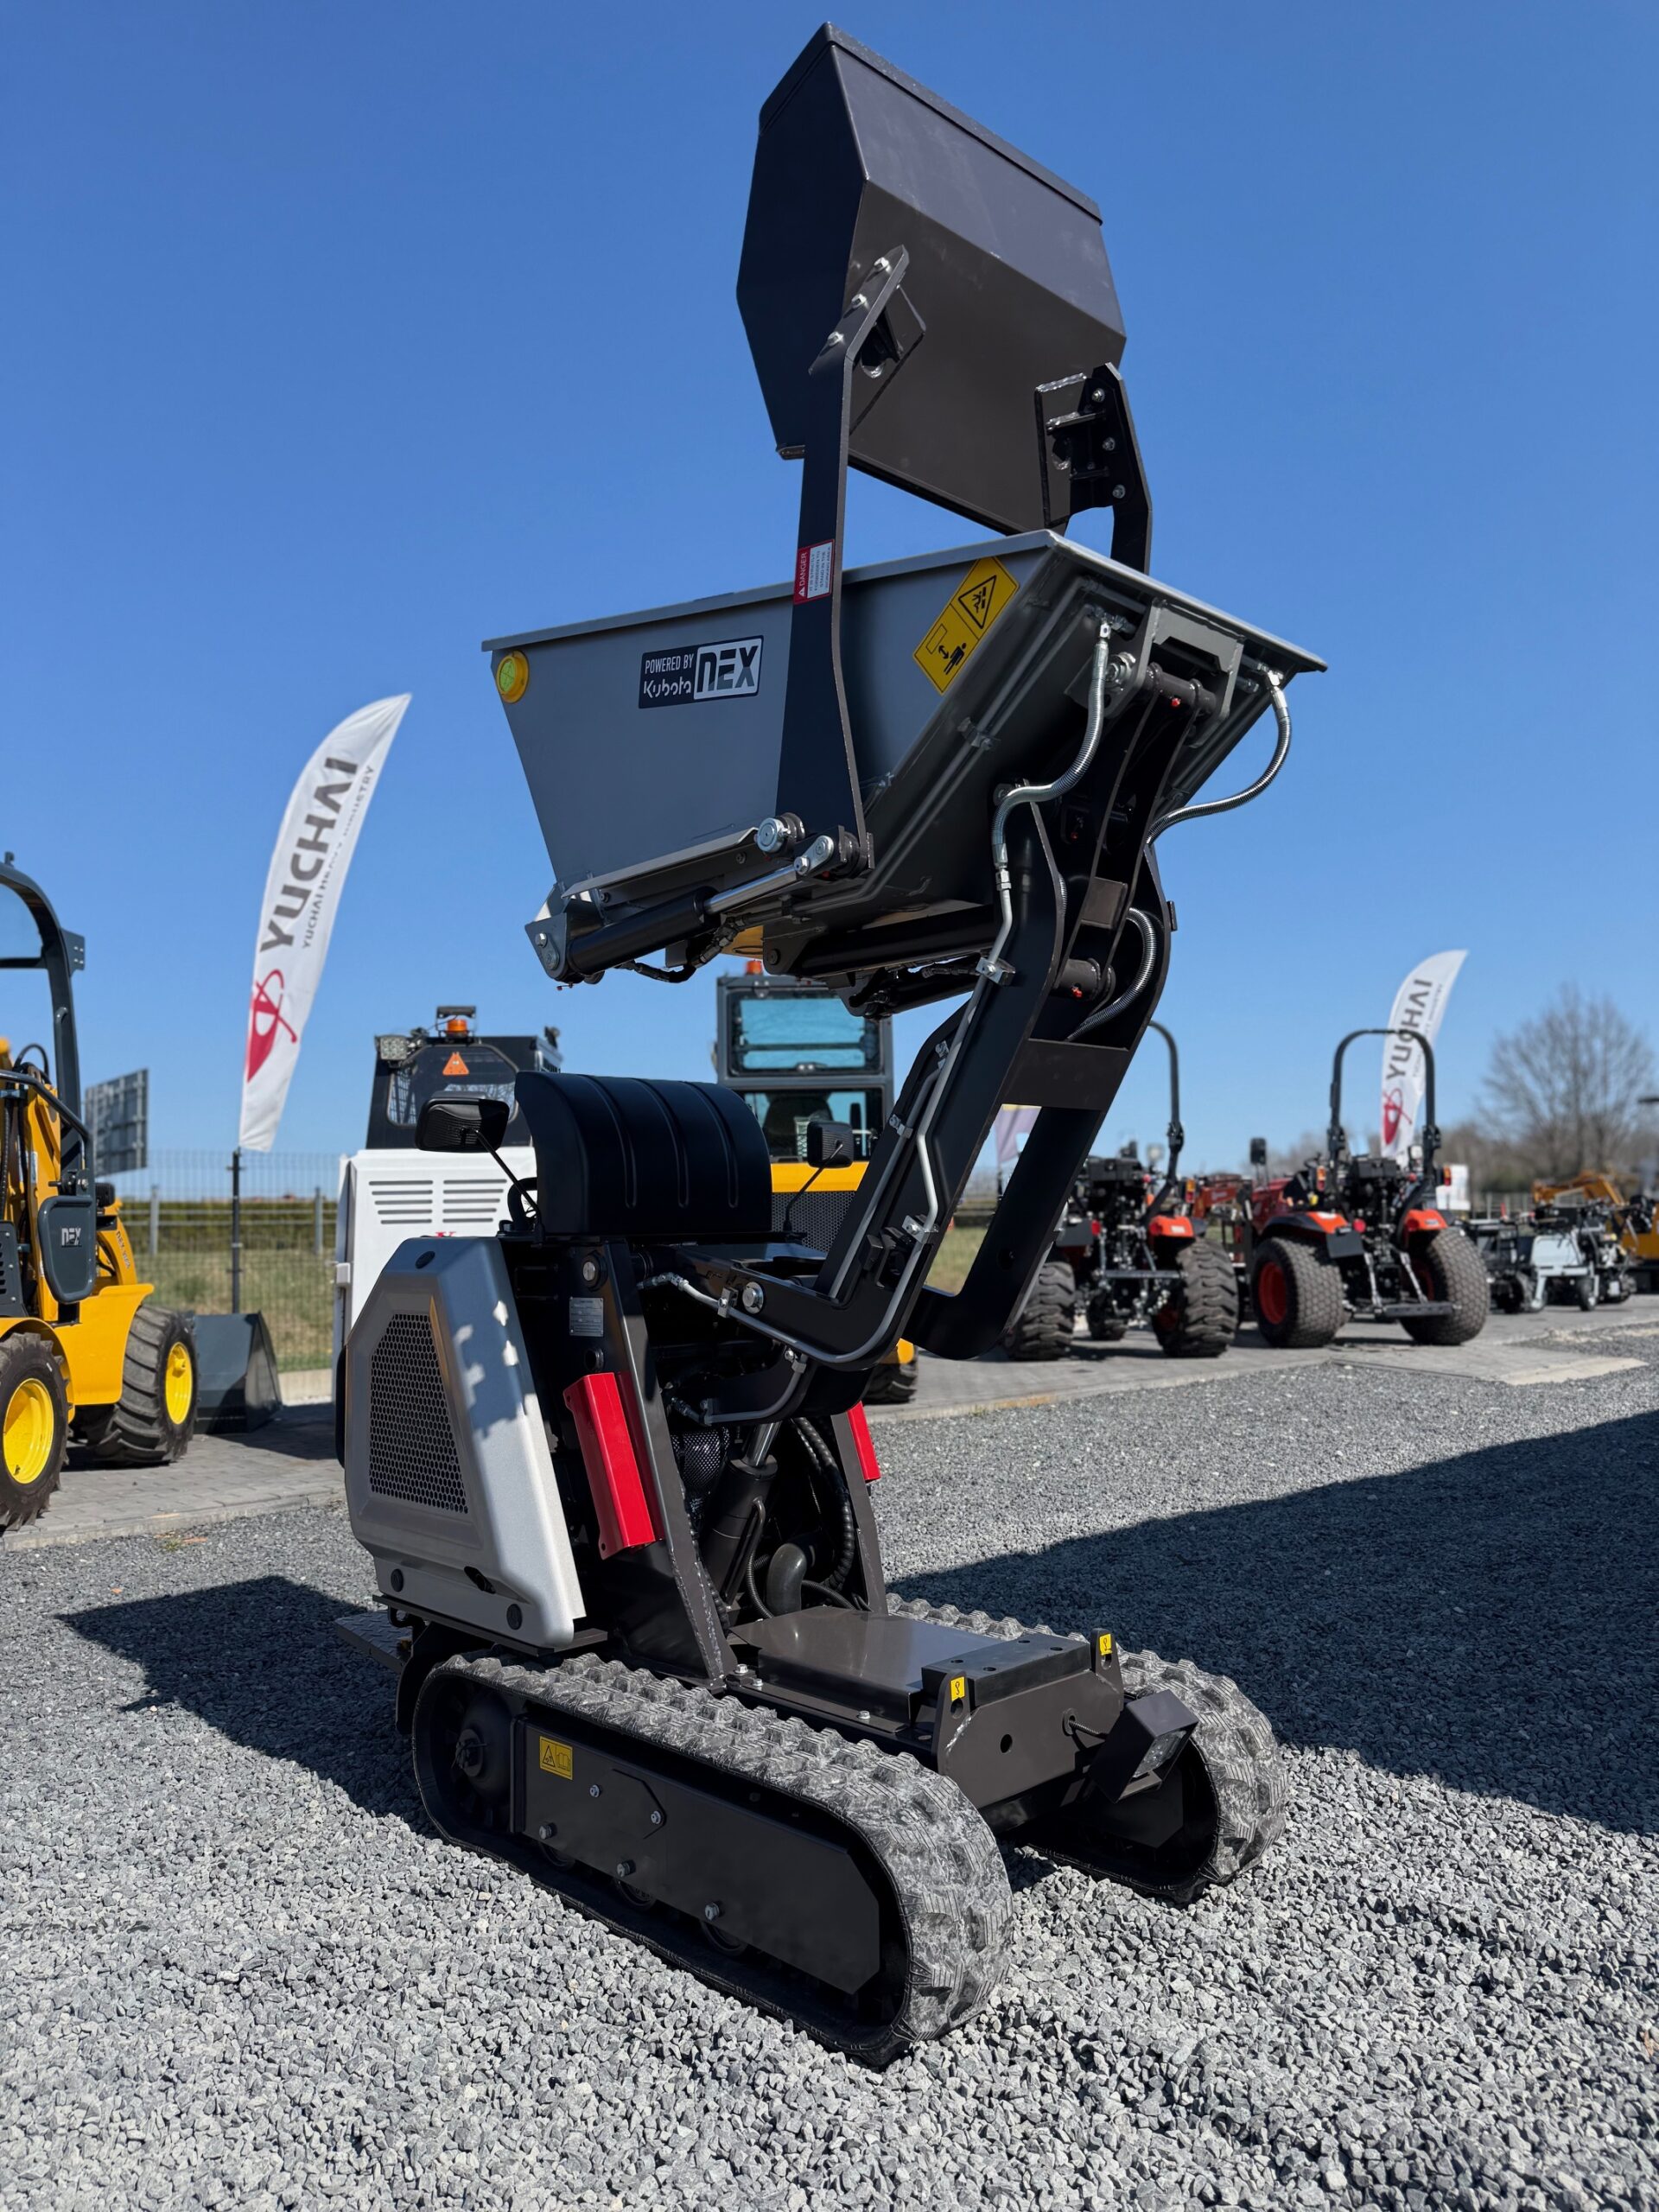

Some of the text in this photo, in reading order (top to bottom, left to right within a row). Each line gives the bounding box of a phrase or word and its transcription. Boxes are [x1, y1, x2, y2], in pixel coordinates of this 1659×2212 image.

[799, 552, 808, 587] DANGER
[645, 653, 695, 674] POWERED BY
[643, 676, 691, 698] Kubota
[259, 757, 358, 952] YUCHAI
[302, 893, 324, 950] YUCHAI
